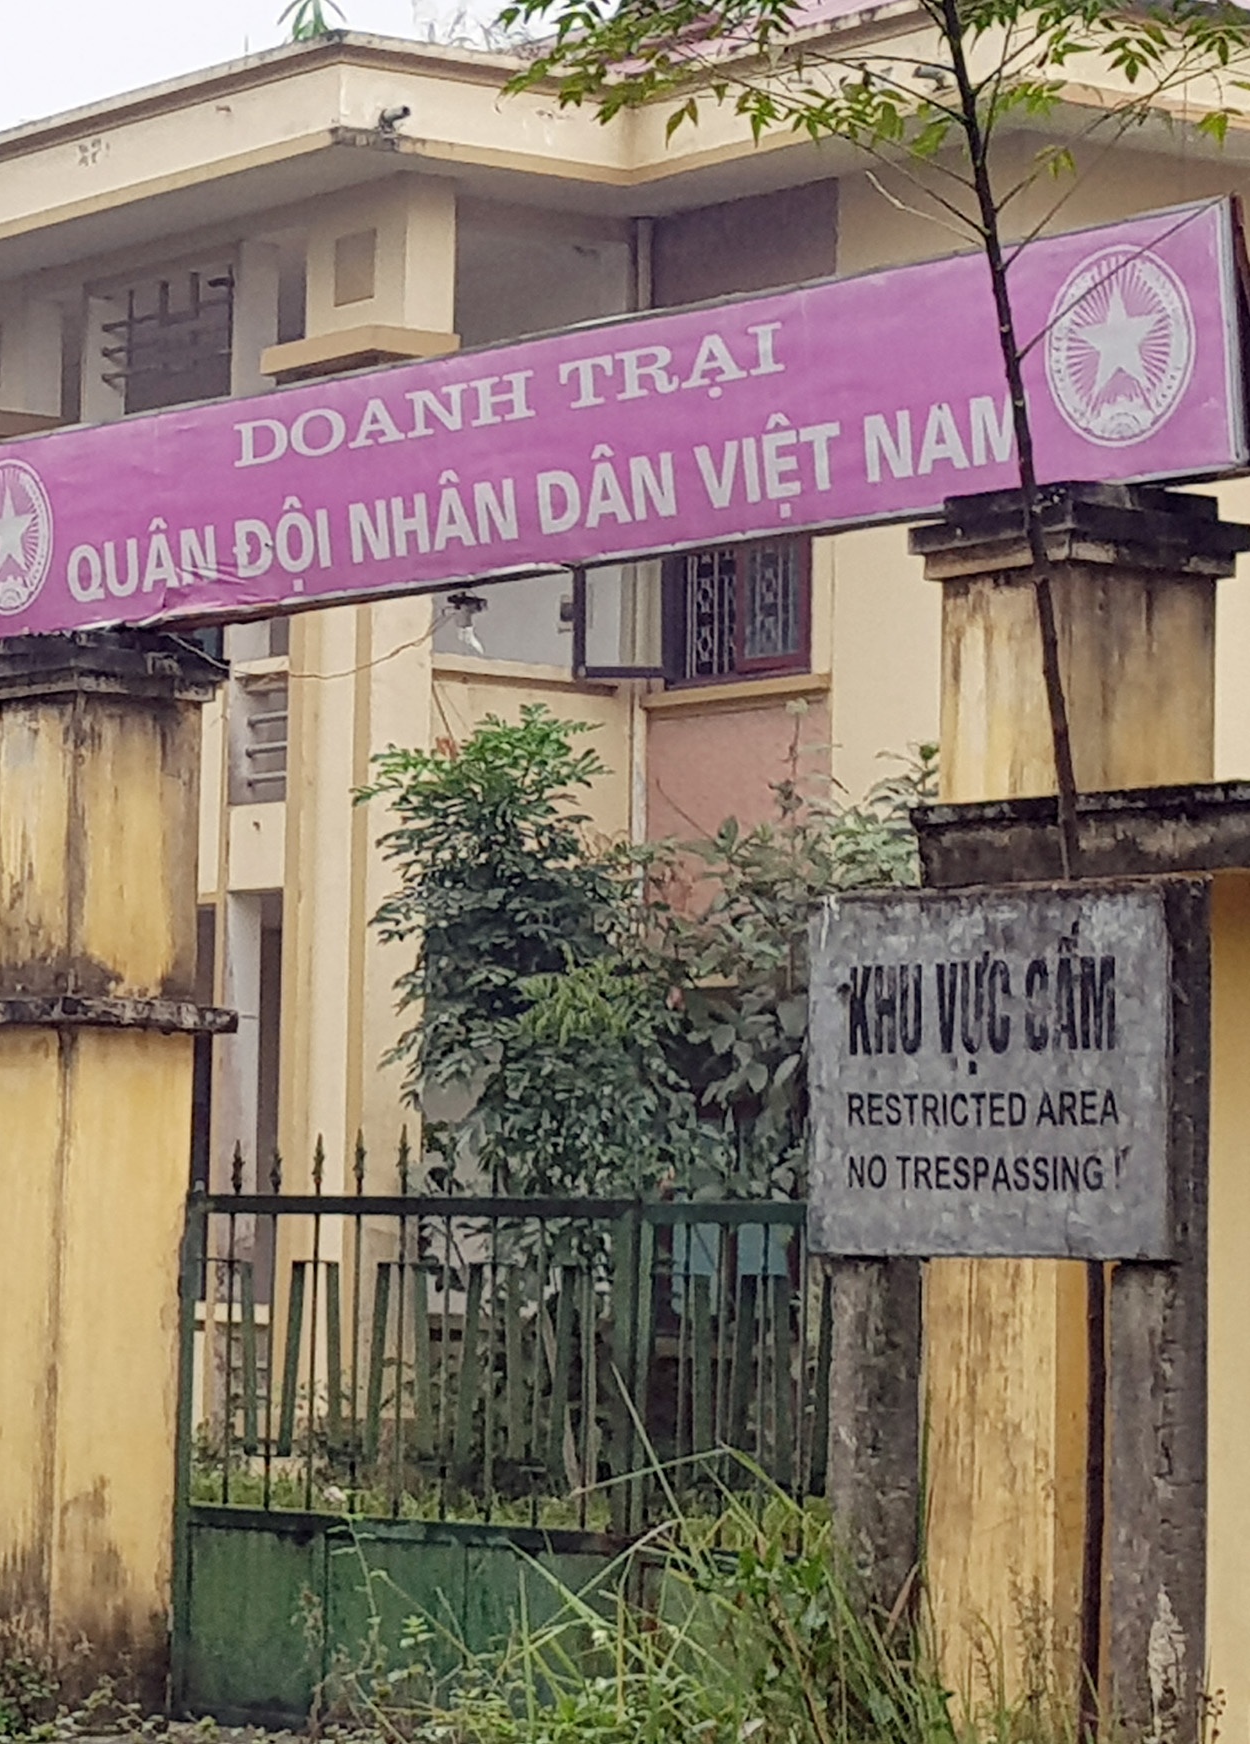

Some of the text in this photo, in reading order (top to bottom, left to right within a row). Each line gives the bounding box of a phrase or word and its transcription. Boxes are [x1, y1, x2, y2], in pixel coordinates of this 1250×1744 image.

[233, 322, 785, 468] DOANH TRẠI
[66, 390, 1032, 602] QUÂN ĐỘI NHÂN DÂN VIỆT NAM
[849, 963, 923, 1055] KHU
[847, 1089, 1120, 1127] RESTRICTED AREA
[848, 1155, 888, 1189] NO
[896, 1156, 1103, 1192] TRESPASSING
